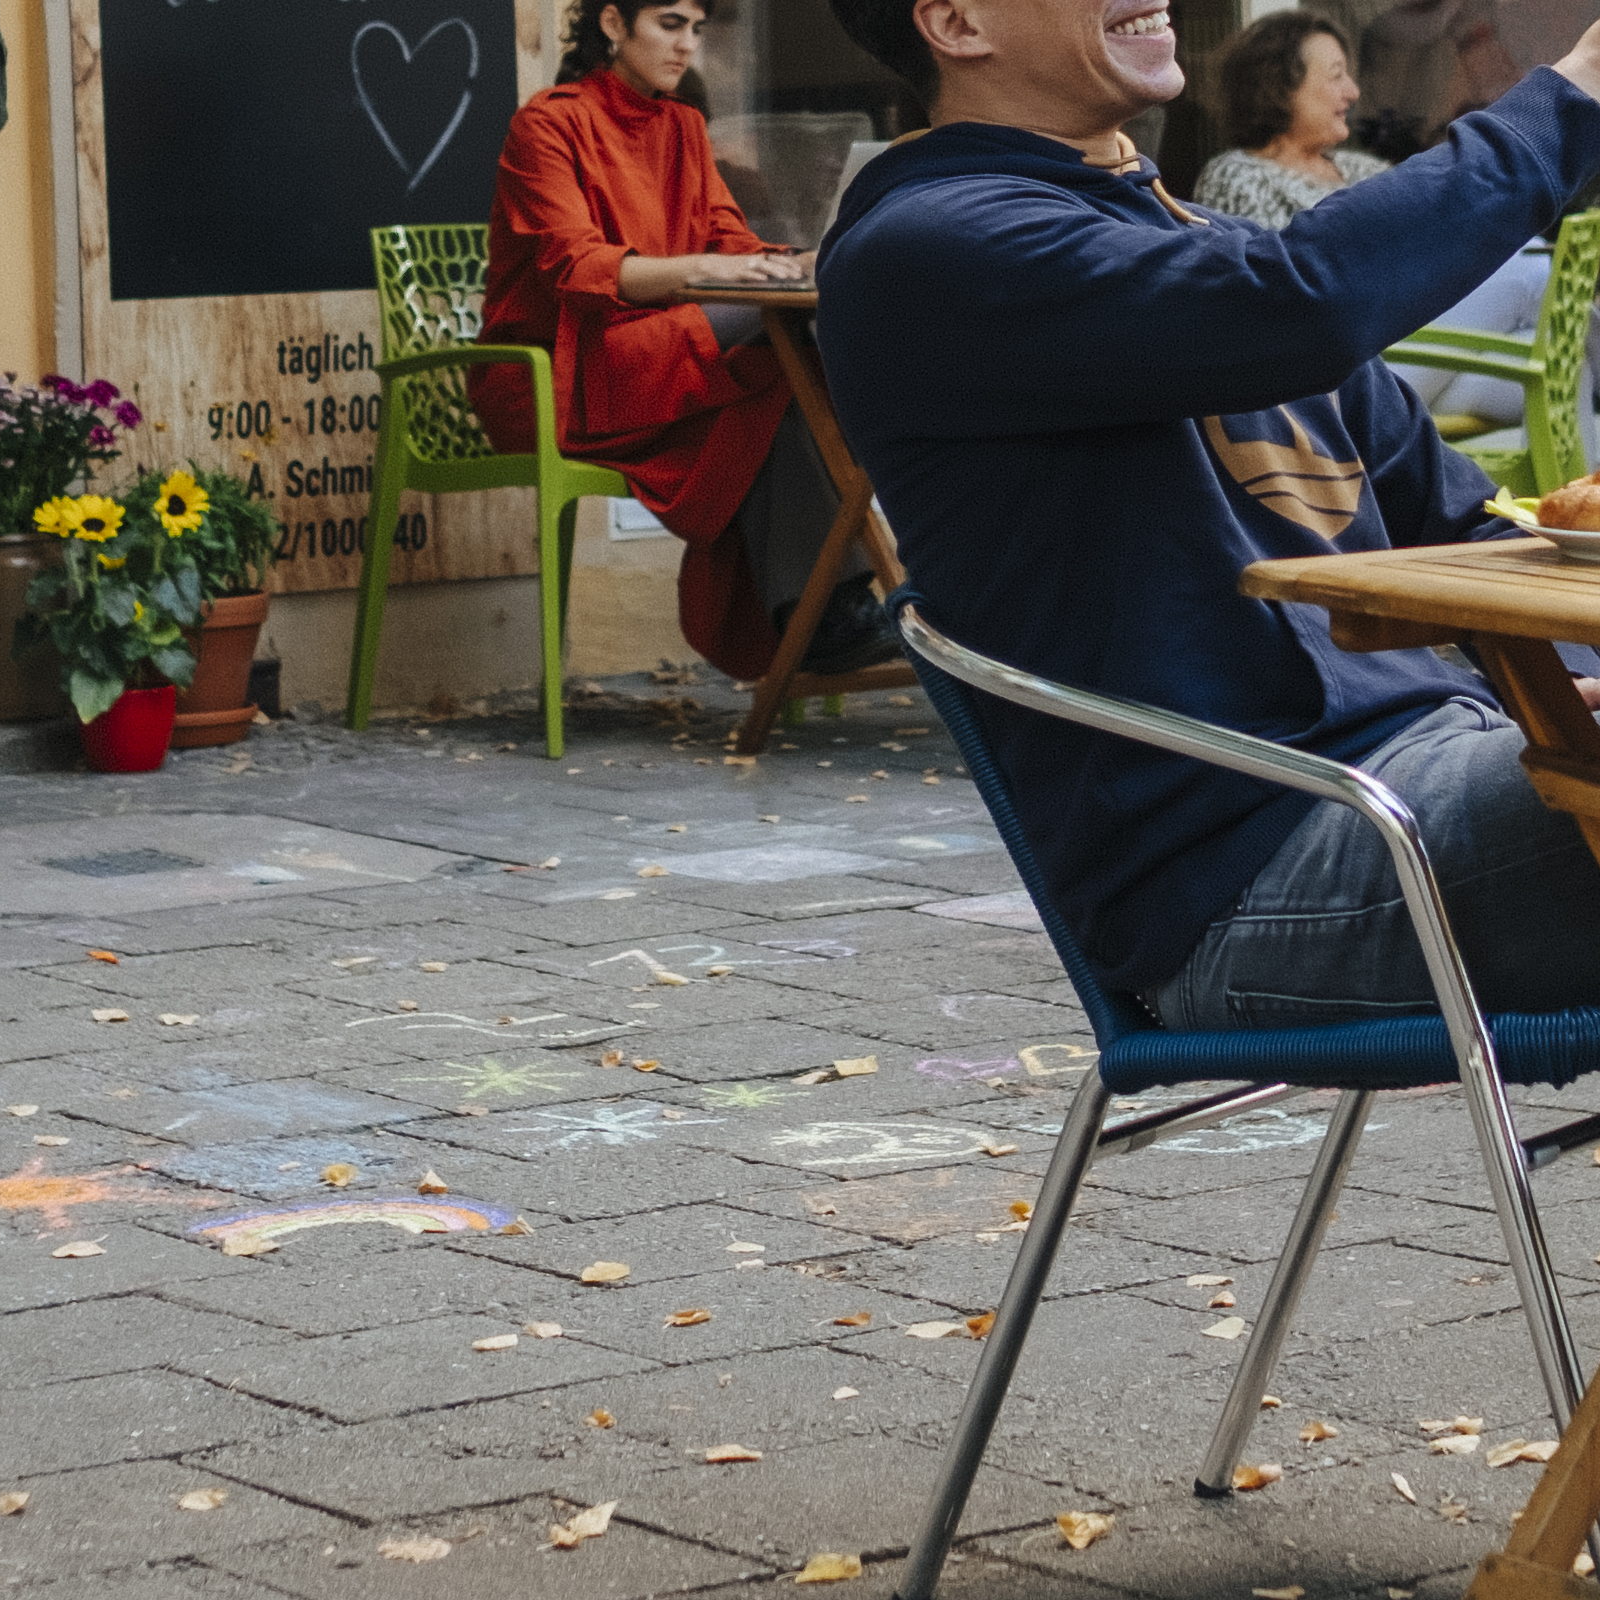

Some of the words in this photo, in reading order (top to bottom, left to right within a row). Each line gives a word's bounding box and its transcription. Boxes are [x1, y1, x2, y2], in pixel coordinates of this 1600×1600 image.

[276, 330, 374, 385] täglich
[207, 399, 272, 442] 9:00
[303, 393, 383, 436] 18:00
[285, 455, 375, 499] Schmi
